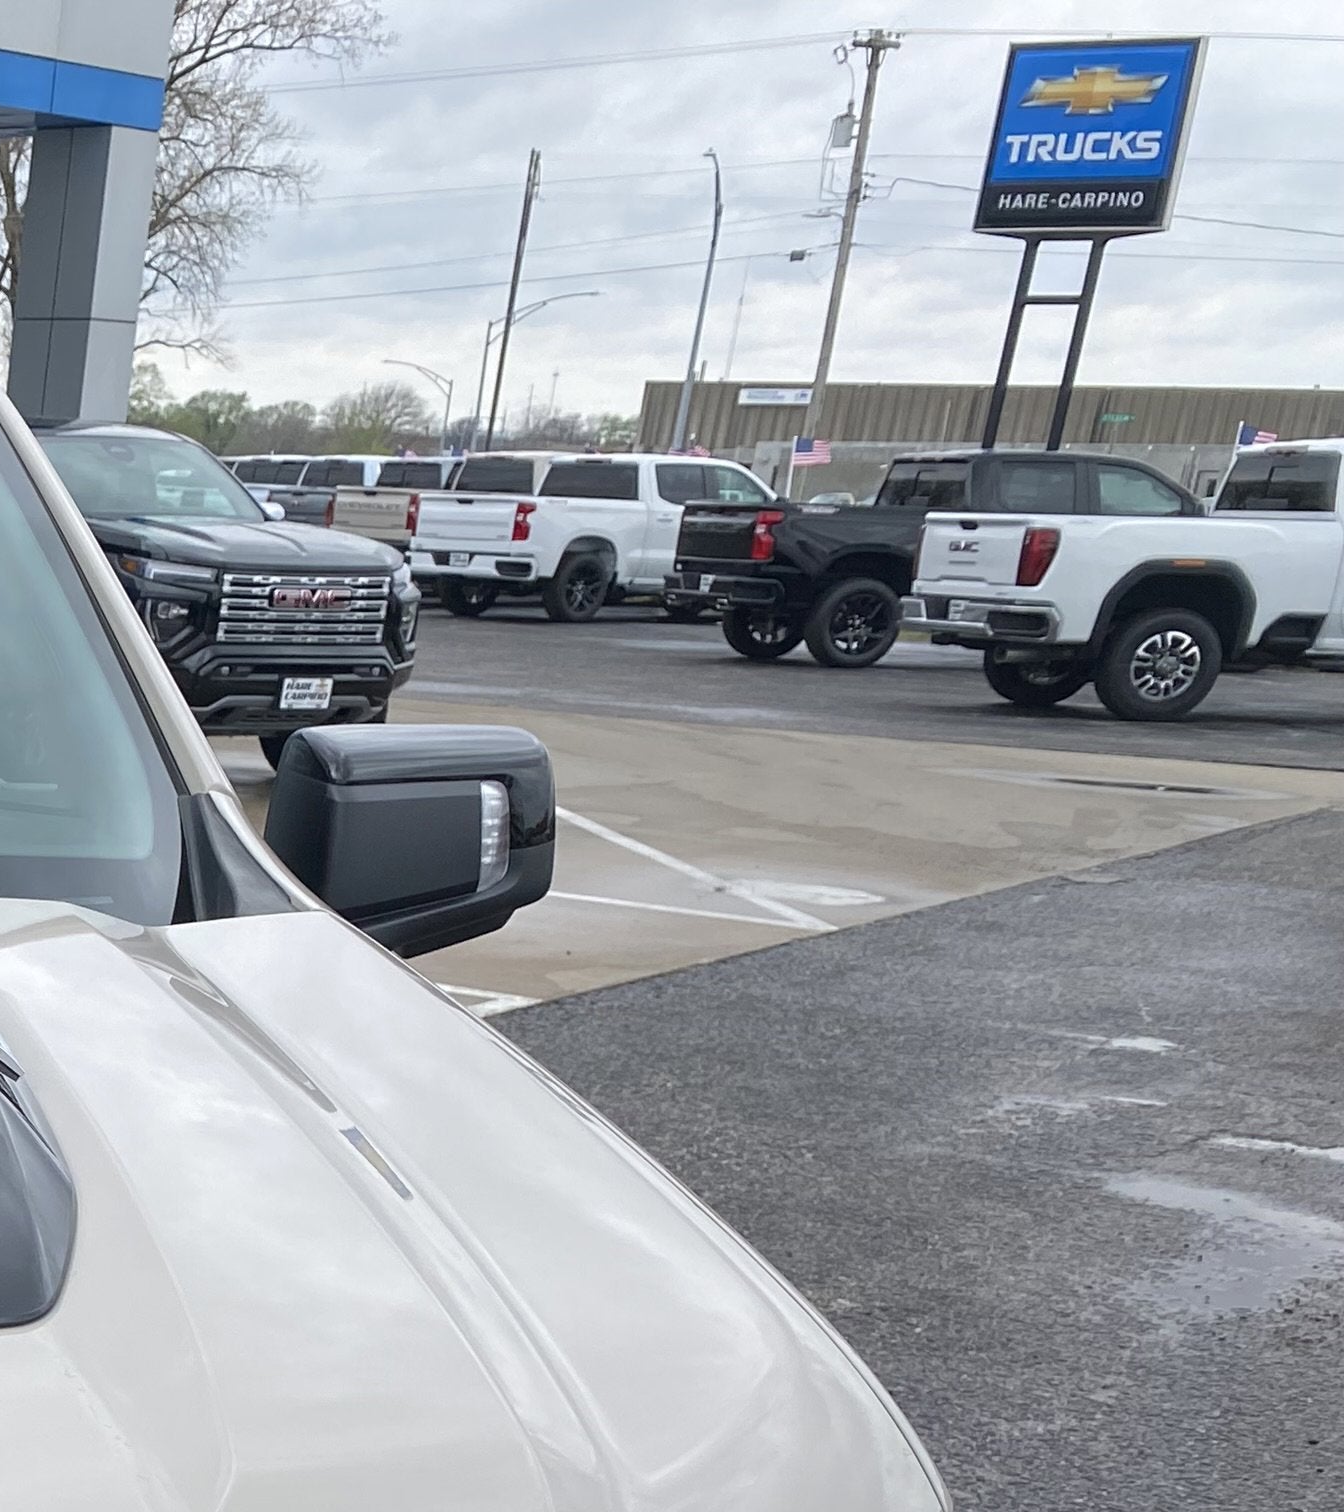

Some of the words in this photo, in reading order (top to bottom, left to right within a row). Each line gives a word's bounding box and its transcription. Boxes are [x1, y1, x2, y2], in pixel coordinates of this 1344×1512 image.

[1006, 130, 1162, 163] TRUCKS
[949, 540, 979, 553] GMC
[273, 588, 352, 609] GMC
